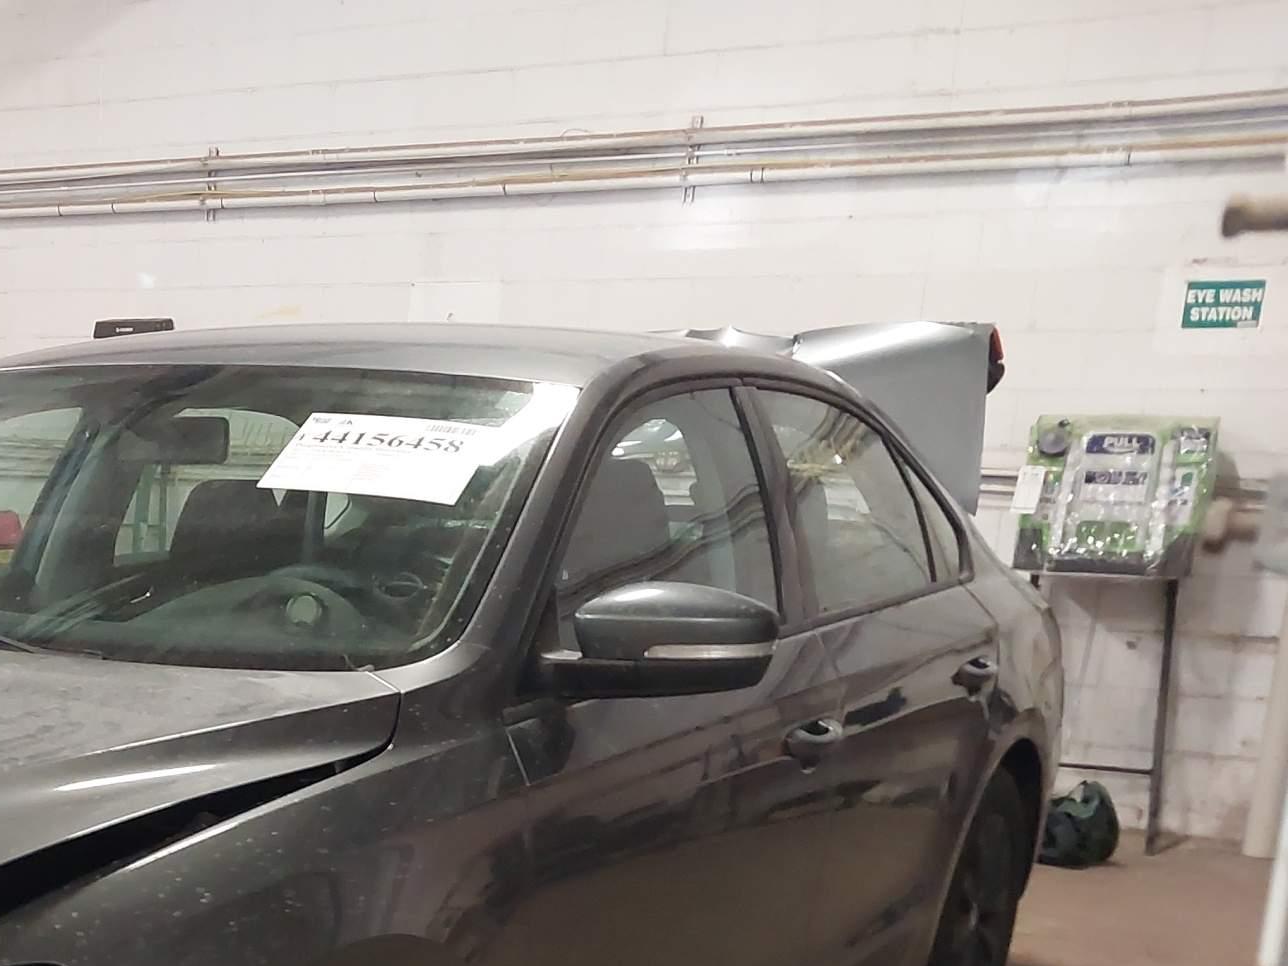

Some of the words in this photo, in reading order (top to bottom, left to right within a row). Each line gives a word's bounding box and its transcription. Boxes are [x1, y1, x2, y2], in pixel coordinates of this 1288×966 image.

[1186, 288, 1216, 304] EYE
[1219, 287, 1264, 303] WASH
[1189, 306, 1254, 322] STATION
[1102, 436, 1142, 449] PULL
